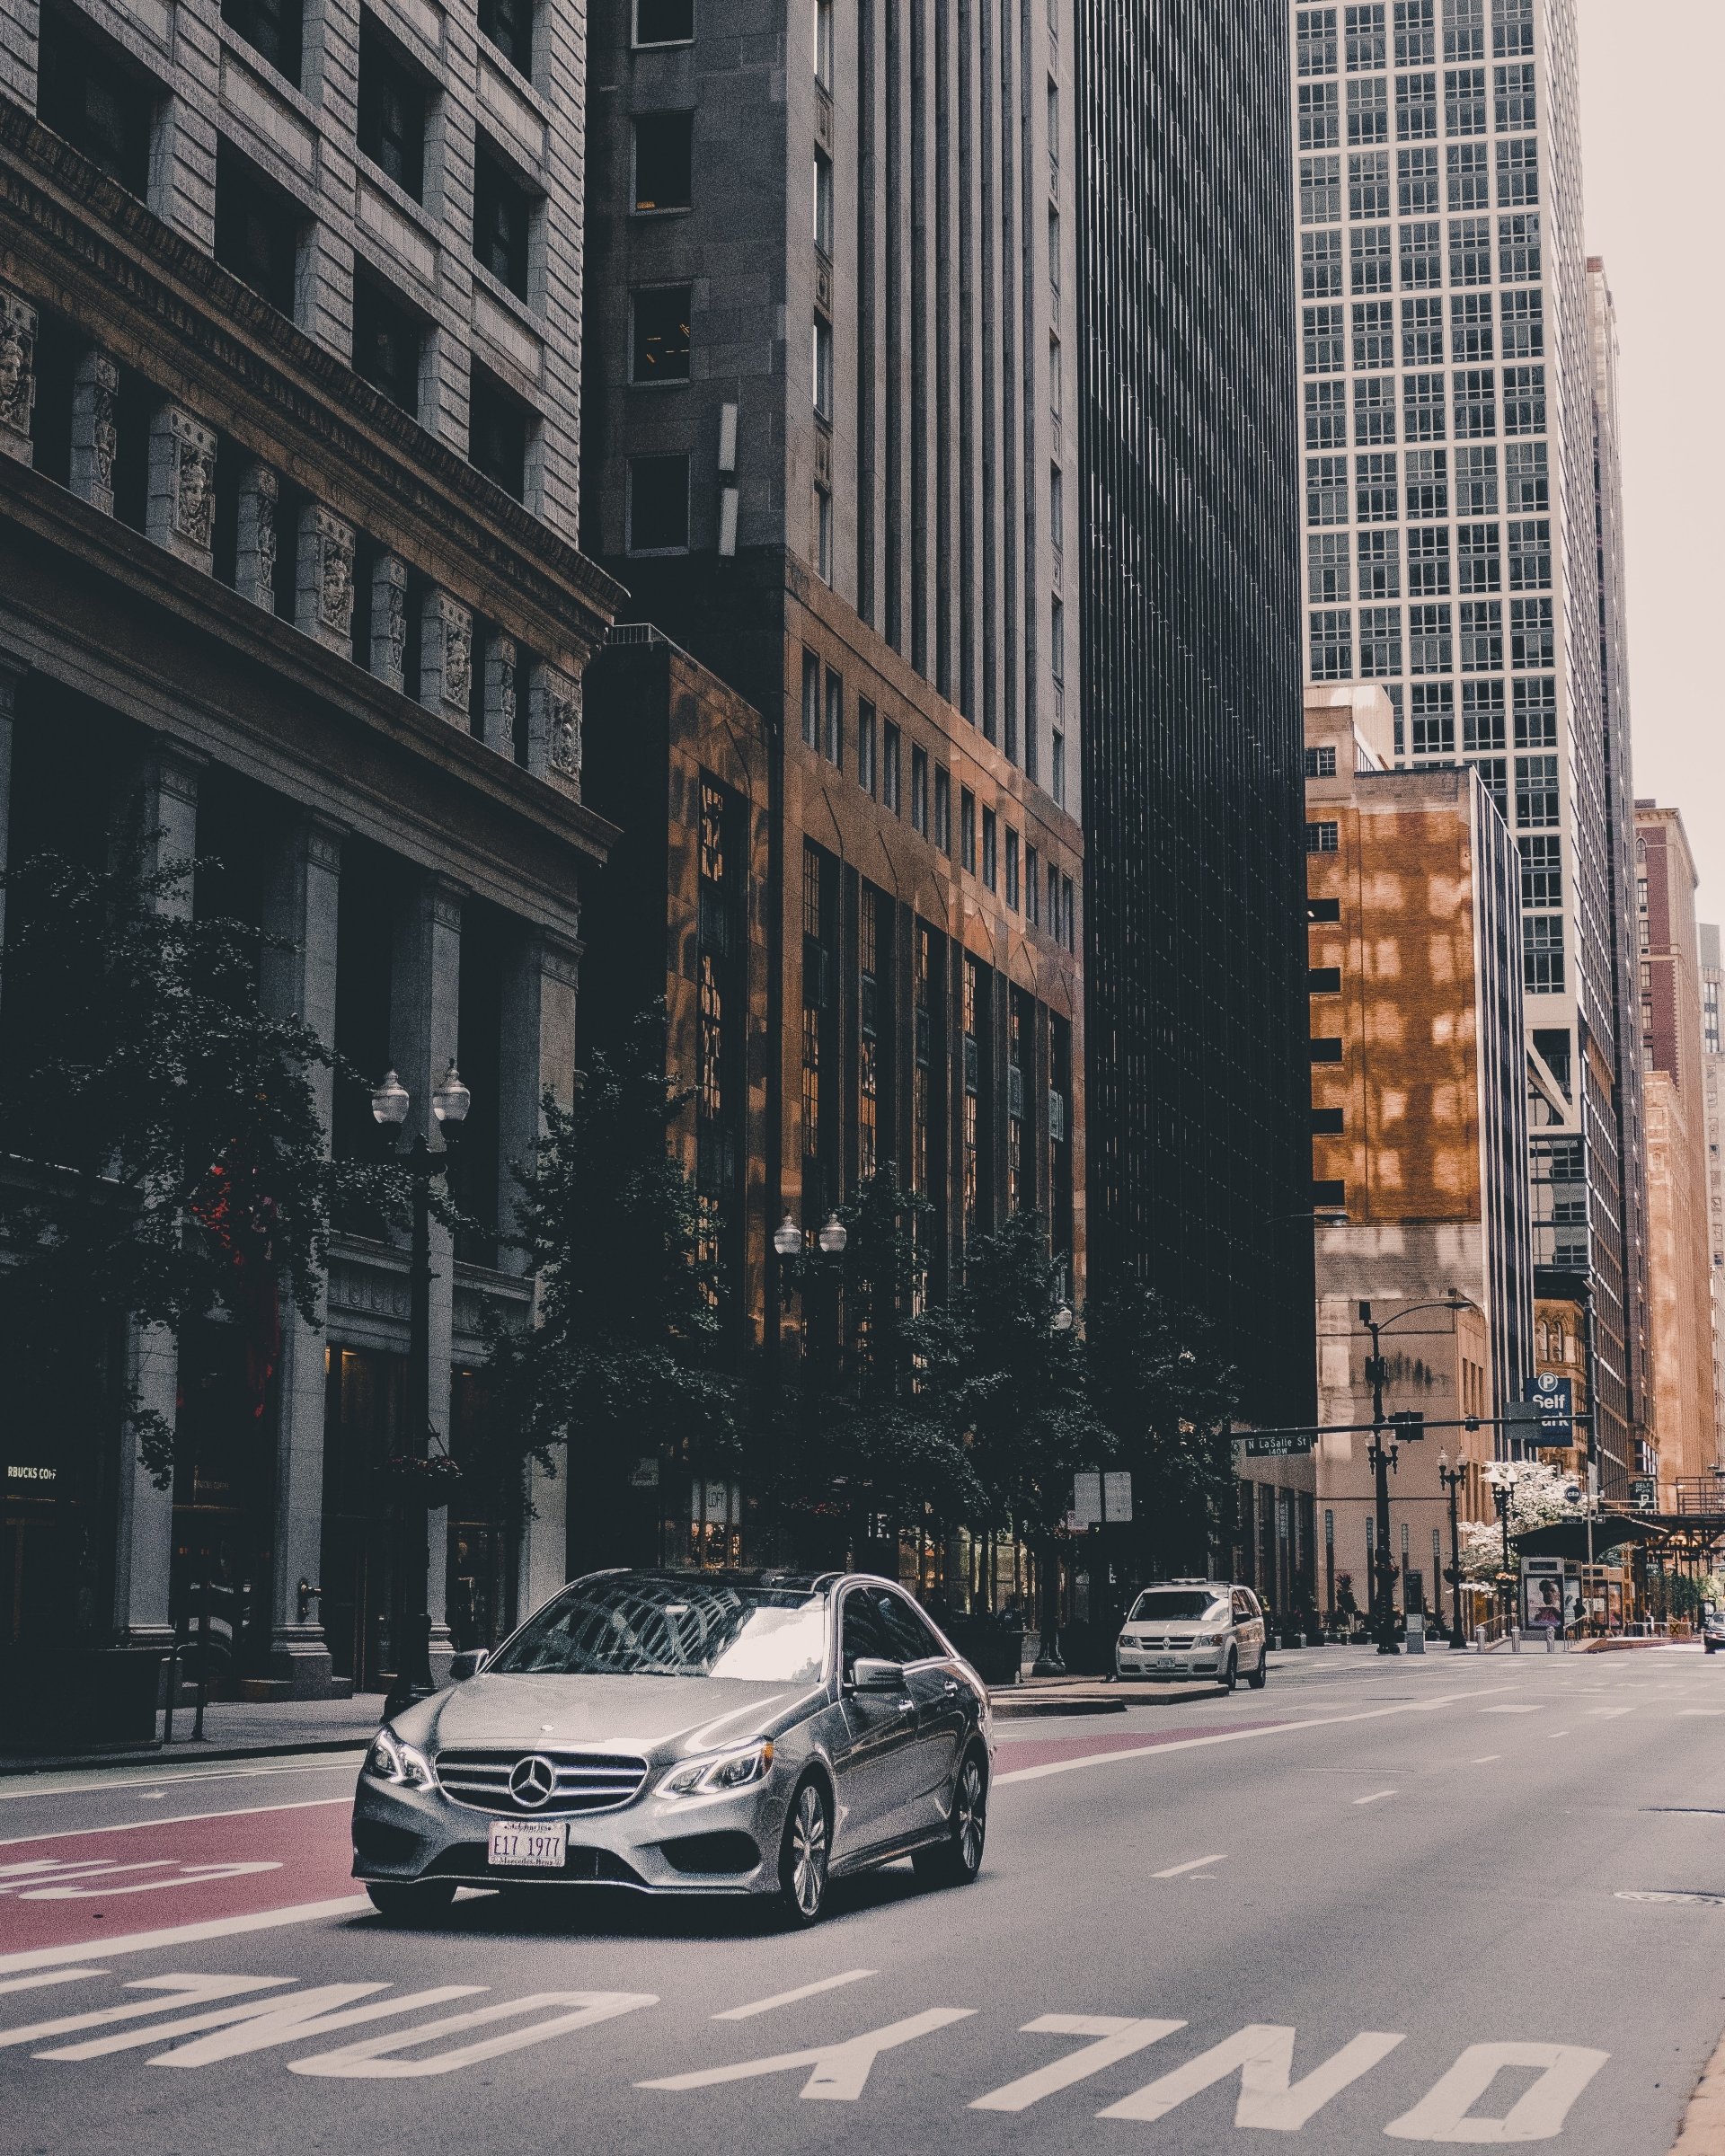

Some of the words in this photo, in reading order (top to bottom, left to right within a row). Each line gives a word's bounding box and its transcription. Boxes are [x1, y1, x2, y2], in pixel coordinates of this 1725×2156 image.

[1543, 1375, 1554, 1389] P
[1532, 1394, 1565, 1409] Self
[1541, 1411, 1569, 1427] ark
[1248, 1440, 1254, 1449] N
[1259, 1438, 1292, 1449] LaSalle
[1296, 1437, 1306, 1446] St
[1269, 1447, 1287, 1455] 140W
[8, 1465, 38, 1479] RBUCKS
[494, 1835, 518, 1855] E17
[527, 1837, 560, 1857] 1977
[631, 2007, 1612, 2144] ONLY
